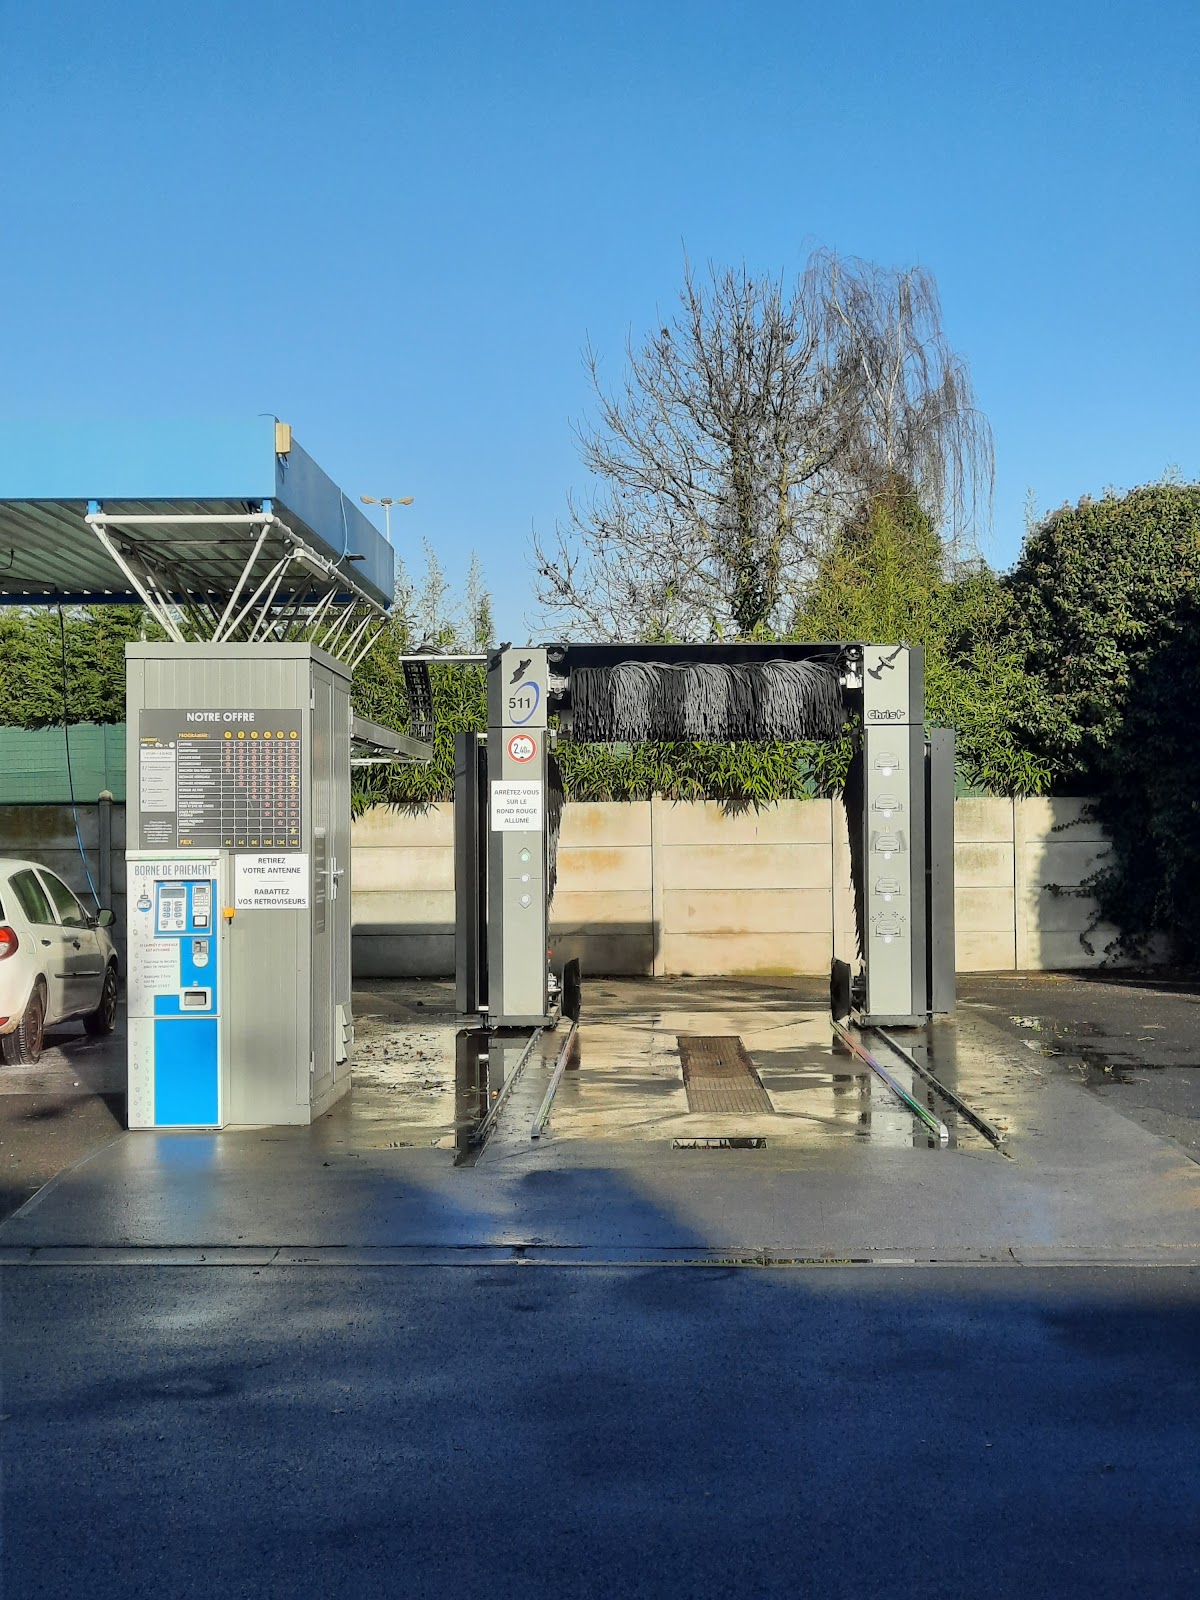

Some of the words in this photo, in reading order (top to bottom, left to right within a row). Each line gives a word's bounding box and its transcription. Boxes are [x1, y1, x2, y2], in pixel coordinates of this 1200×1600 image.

[508, 698, 530, 708] 511
[186, 712, 220, 722] NOTRE
[222, 712, 255, 722] OFFRE
[867, 709, 906, 720] Christ
[135, 865, 160, 875] BORNE
[163, 865, 171, 875] DE
[175, 864, 212, 875] PAIEMENT
